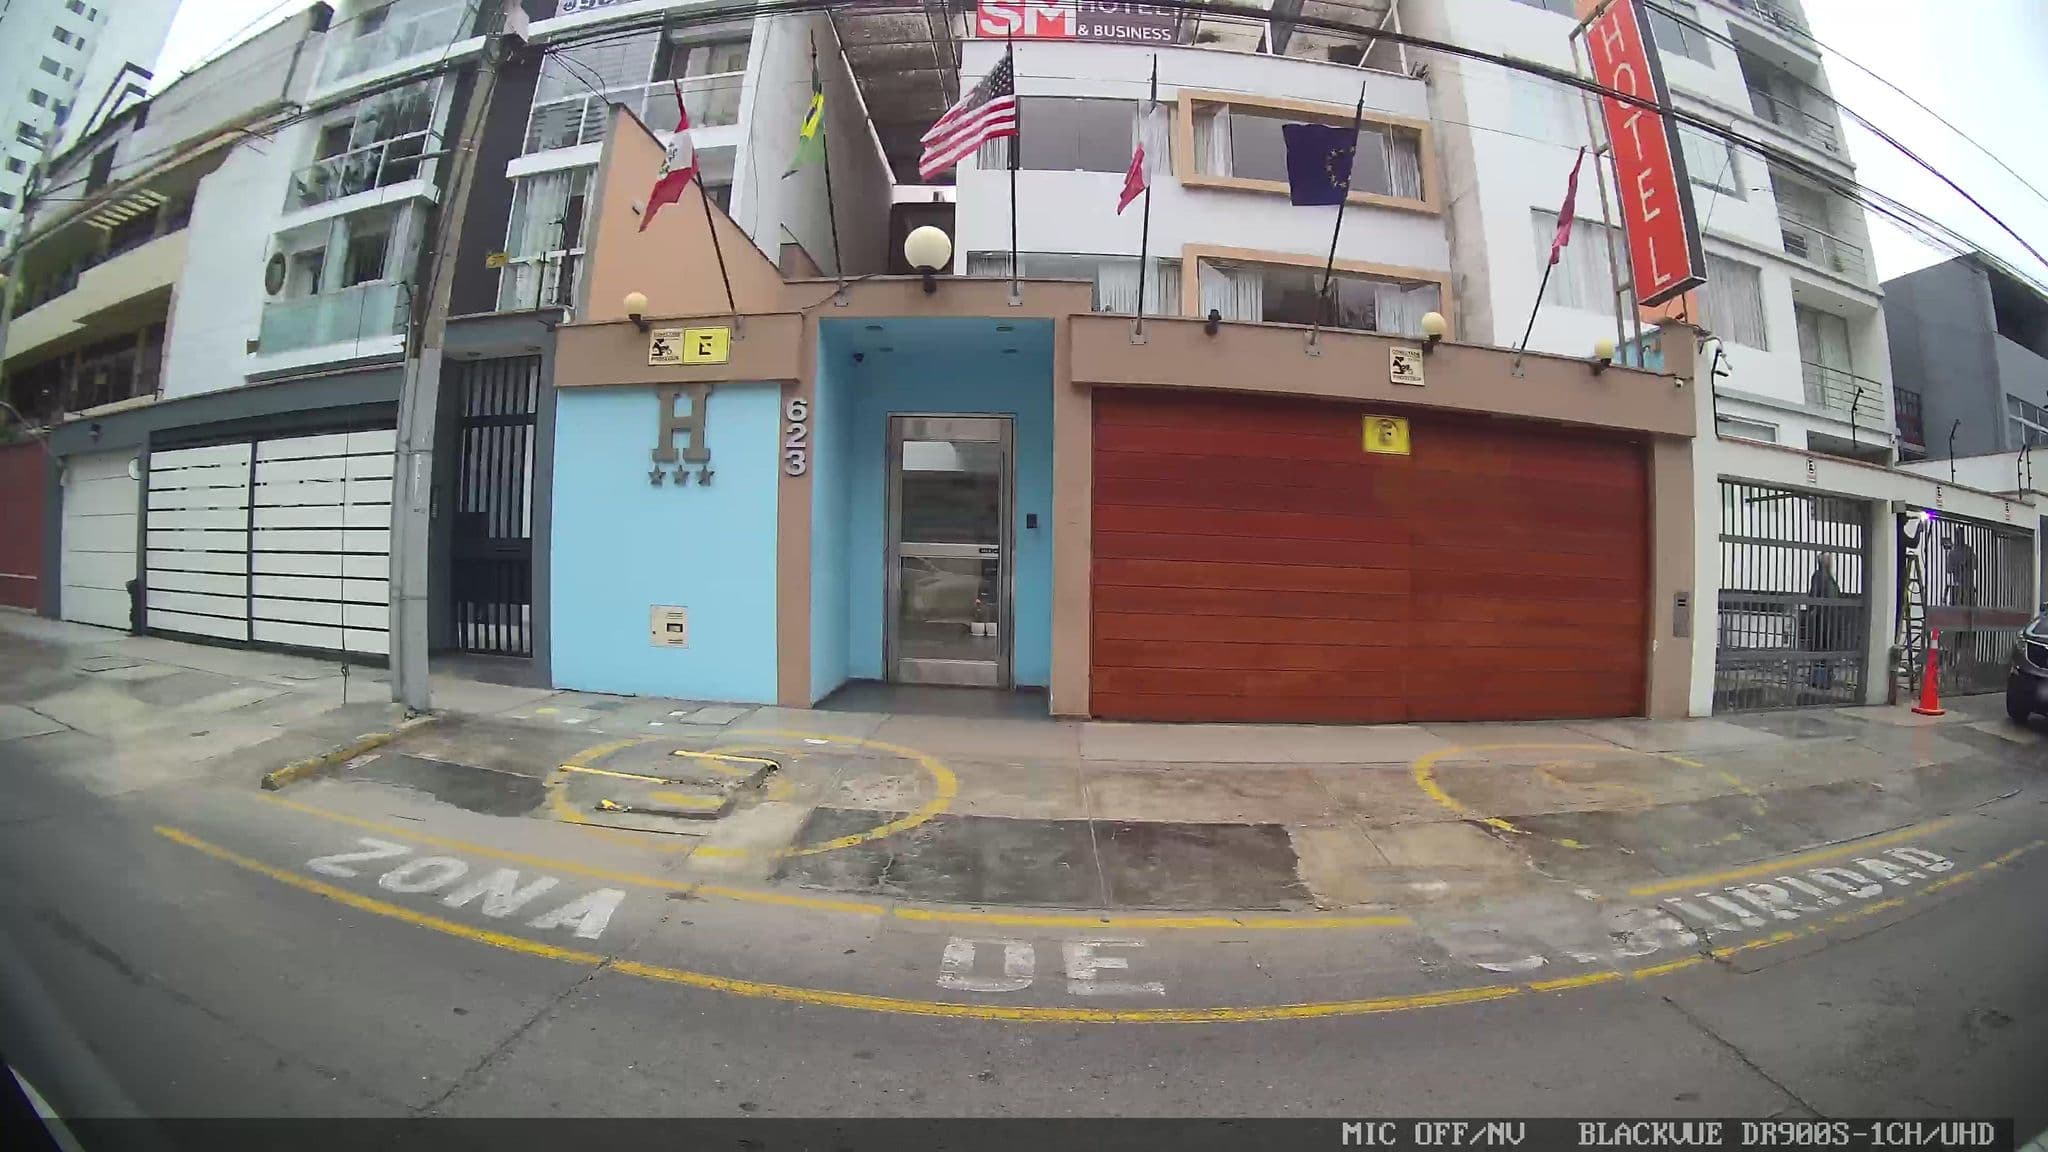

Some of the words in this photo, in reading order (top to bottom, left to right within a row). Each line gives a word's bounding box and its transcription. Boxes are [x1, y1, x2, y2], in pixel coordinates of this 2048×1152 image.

[980, 0, 1076, 36] SM
[1078, 24, 1089, 36] &
[1094, 25, 1172, 41] BUSINESS
[1601, 12, 1672, 287] HOTEL
[651, 382, 714, 463] H
[784, 398, 808, 476] 623
[304, 837, 627, 940] ZONA
[936, 936, 1166, 996] DE
